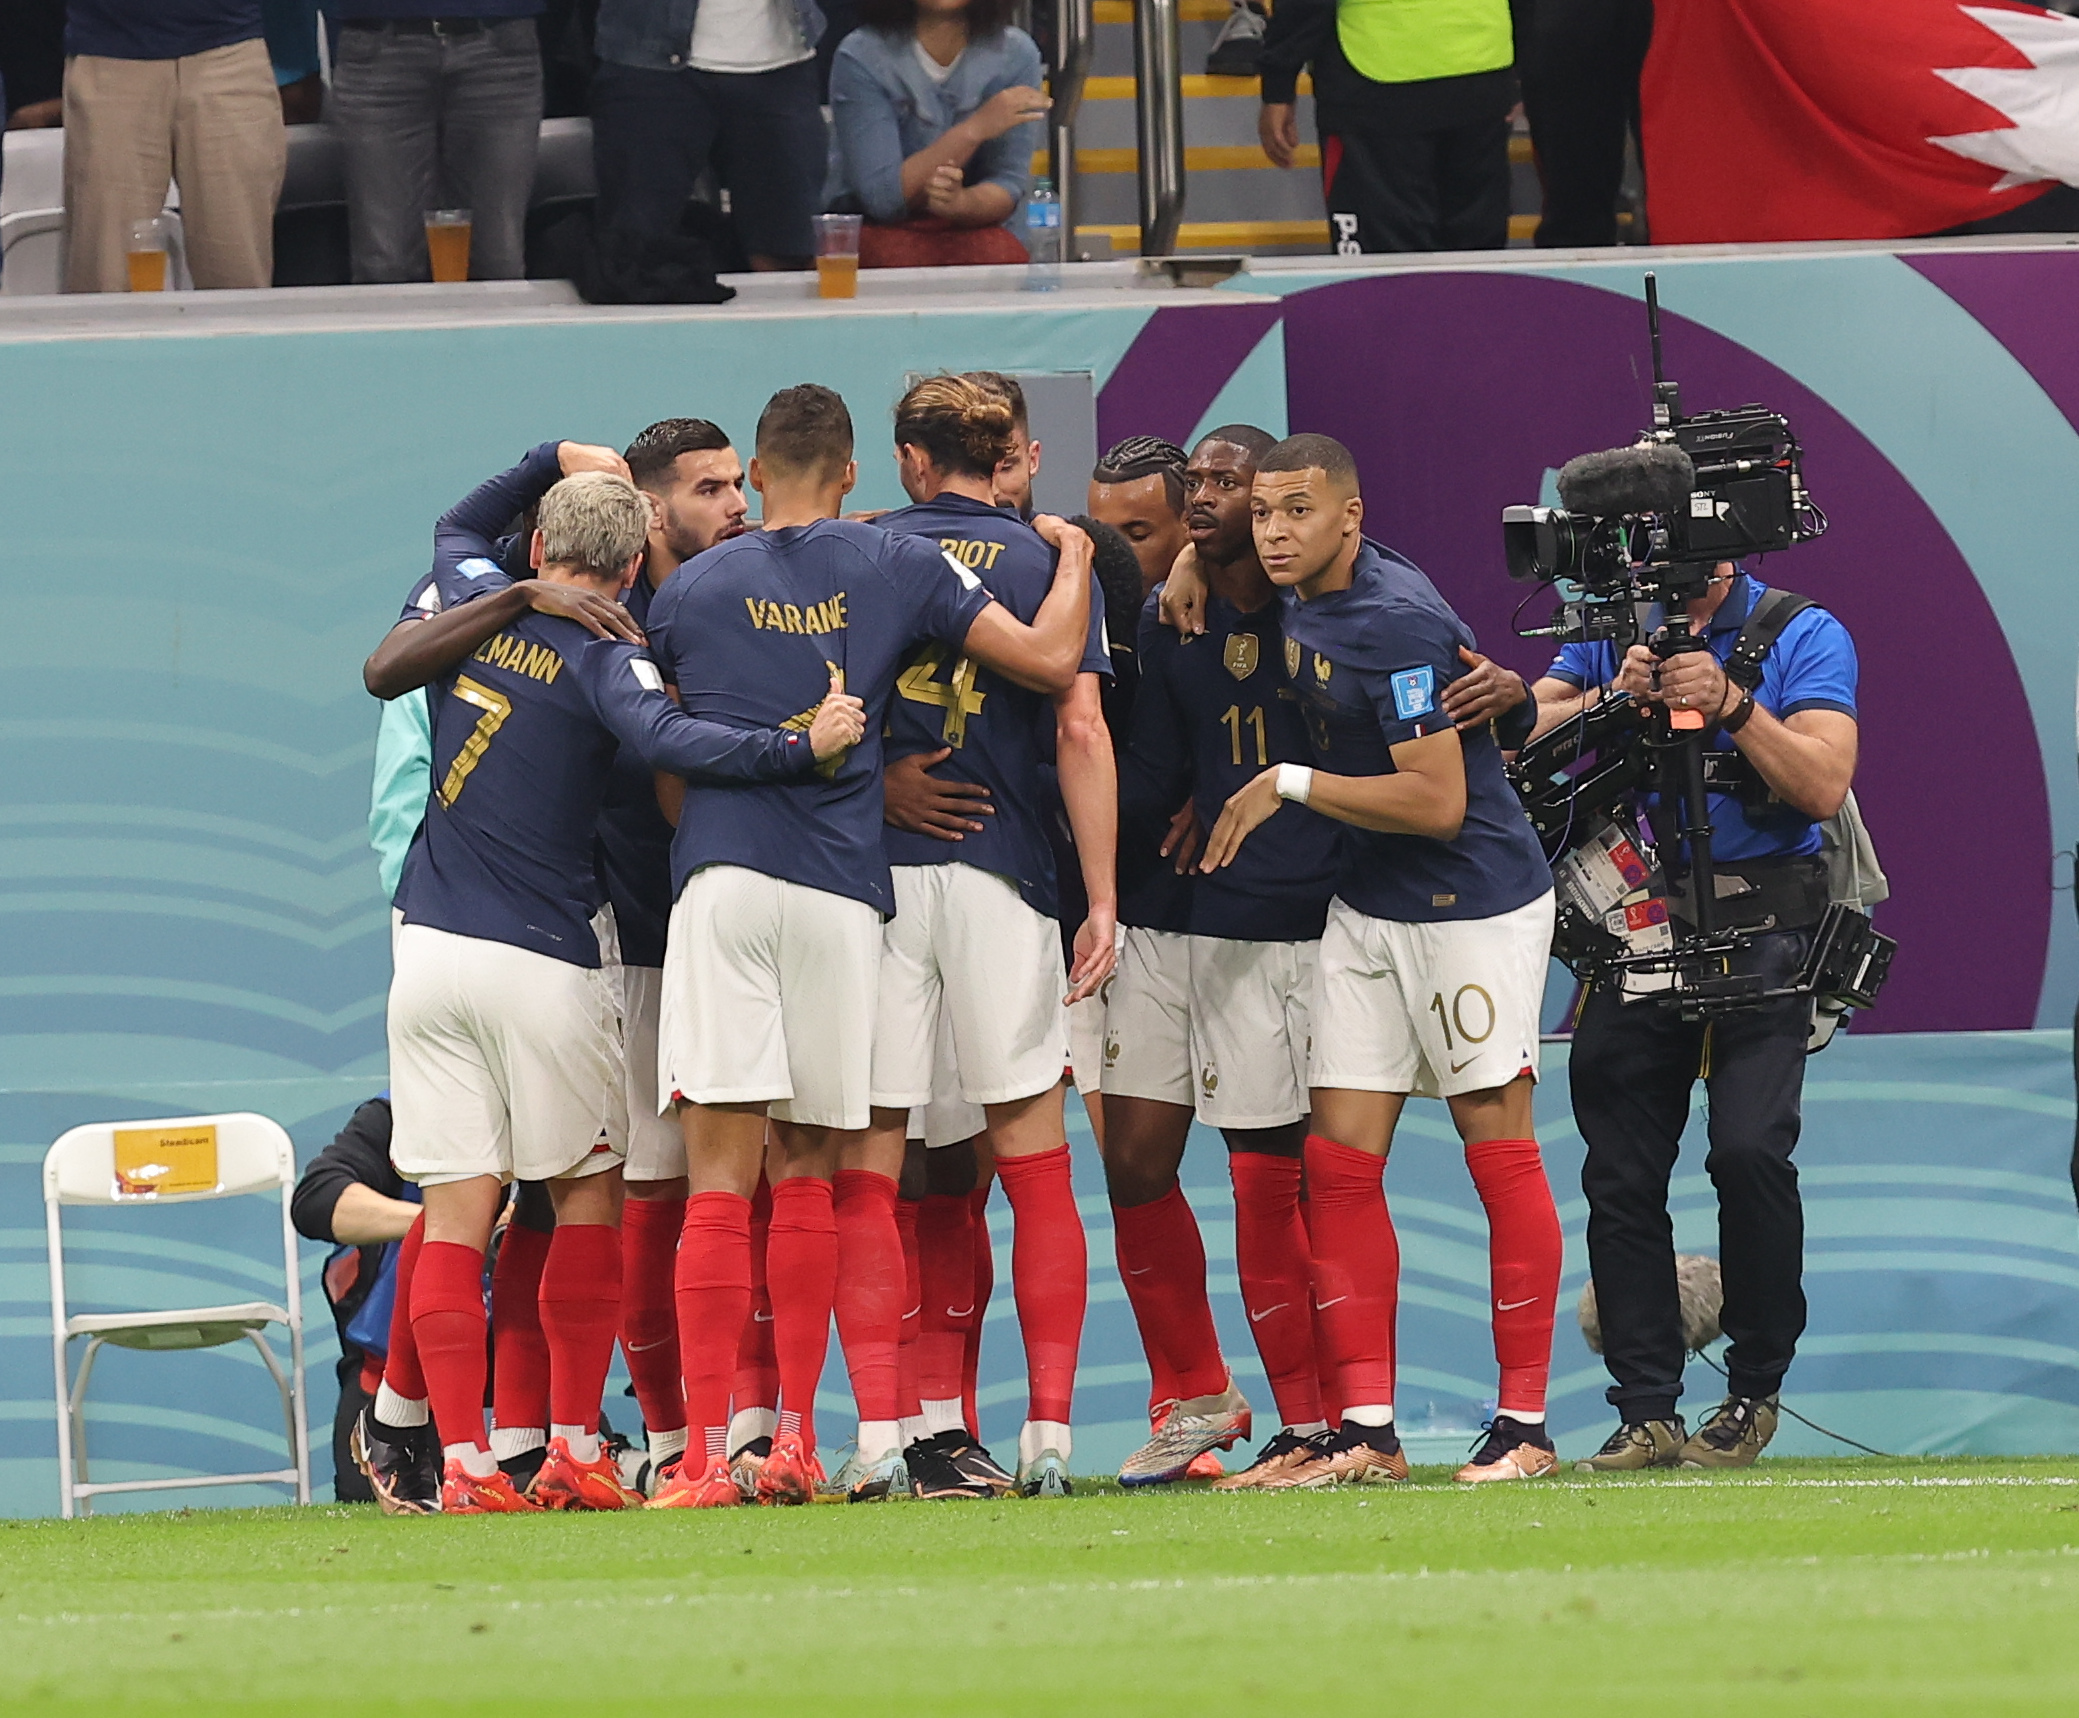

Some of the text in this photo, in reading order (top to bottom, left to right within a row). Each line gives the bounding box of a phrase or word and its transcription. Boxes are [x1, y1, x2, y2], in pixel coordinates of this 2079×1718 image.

[1690, 490, 1716, 499] SONY
[745, 592, 849, 635] VARANE
[436, 674, 512, 811] 7
[1220, 704, 1267, 765] 11
[1430, 983, 1496, 1051] 10
